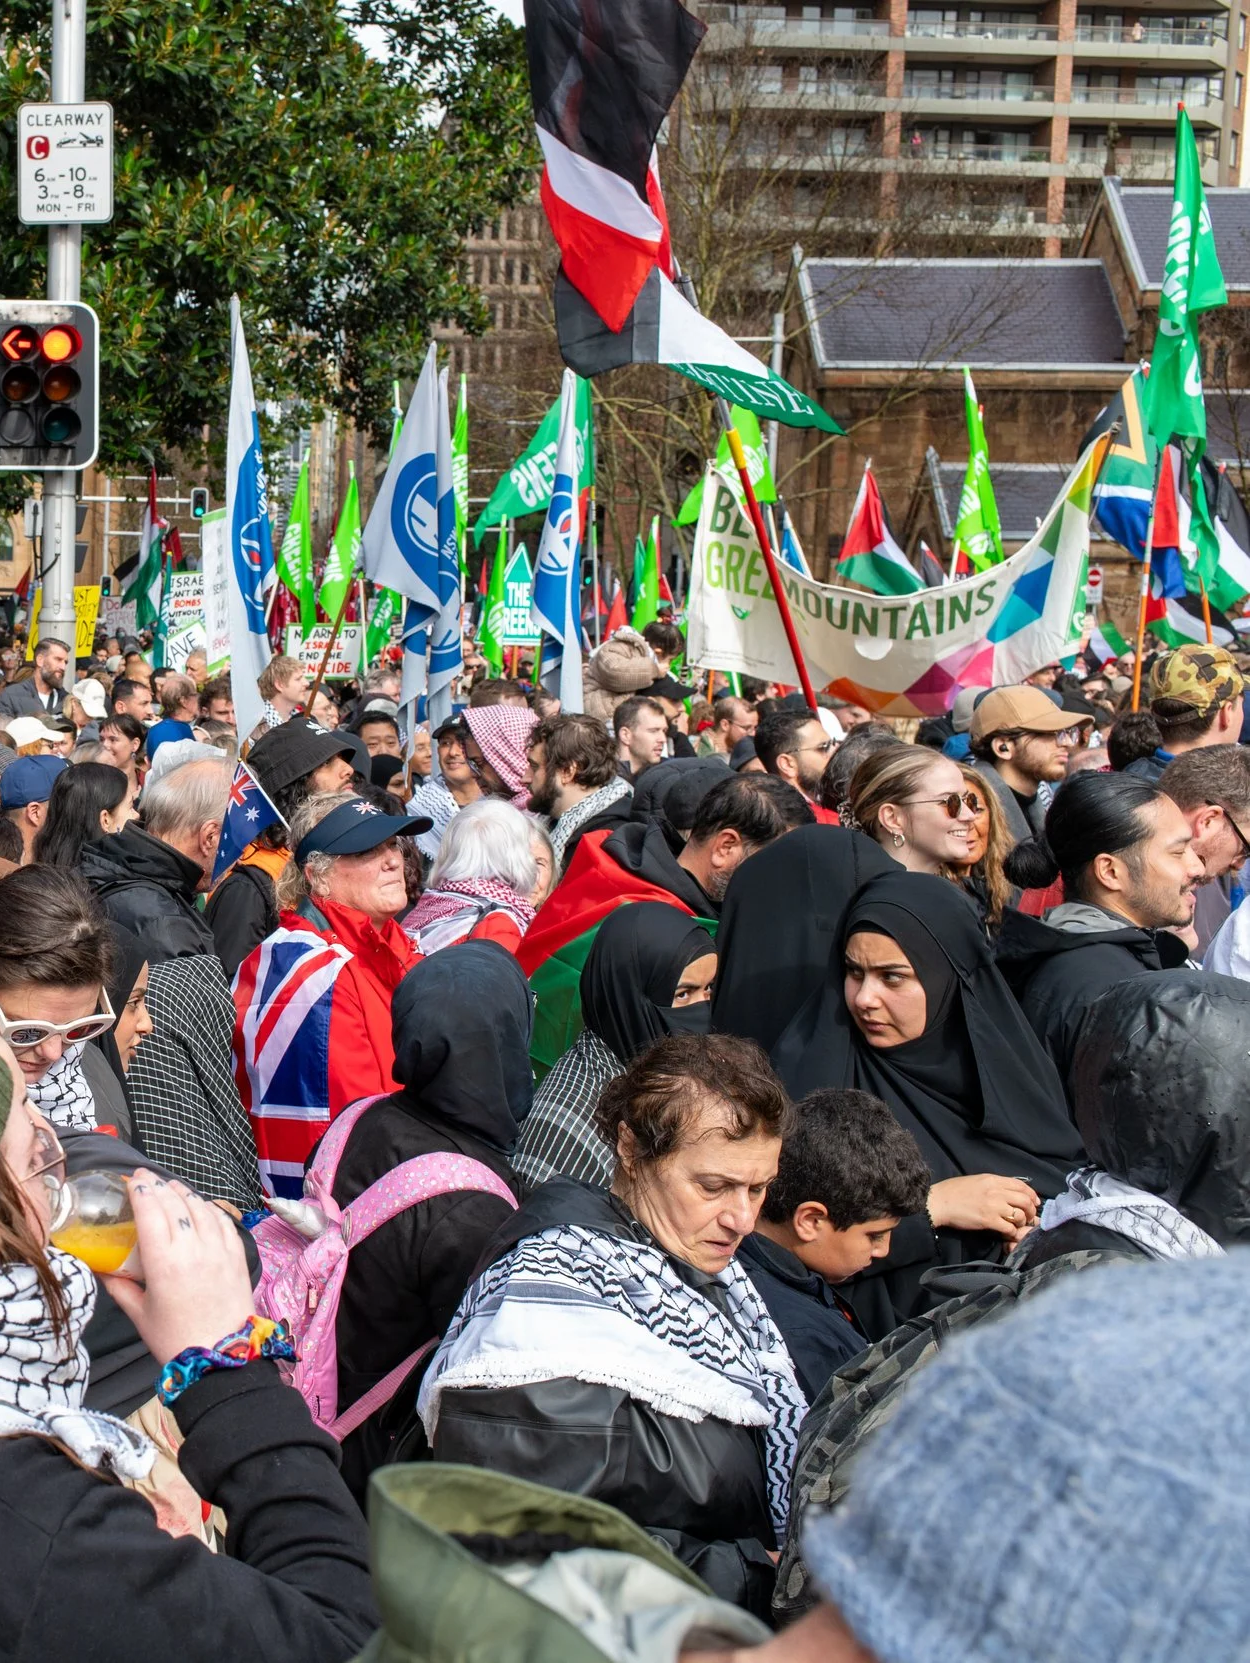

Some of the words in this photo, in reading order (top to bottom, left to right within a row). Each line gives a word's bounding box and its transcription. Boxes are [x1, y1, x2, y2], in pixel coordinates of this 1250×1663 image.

[26, 113, 104, 127] CLEARWAY
[30, 136, 46, 159] C
[36, 203, 61, 213] MON
[77, 203, 95, 212] FRI
[709, 484, 752, 540] BL
[706, 541, 779, 602] GREE
[171, 575, 204, 588] ISRAE
[172, 589, 190, 599] AN'T
[507, 582, 531, 606] THE
[174, 600, 202, 609] BOMBS
[779, 568, 997, 640] MOUNTAINS
[168, 609, 202, 618] WITHOUT
[503, 607, 541, 636] REENS
[313, 629, 341, 639] ARM
[344, 629, 356, 639] TO
[299, 651, 319, 660] END
[324, 651, 342, 660] HE
